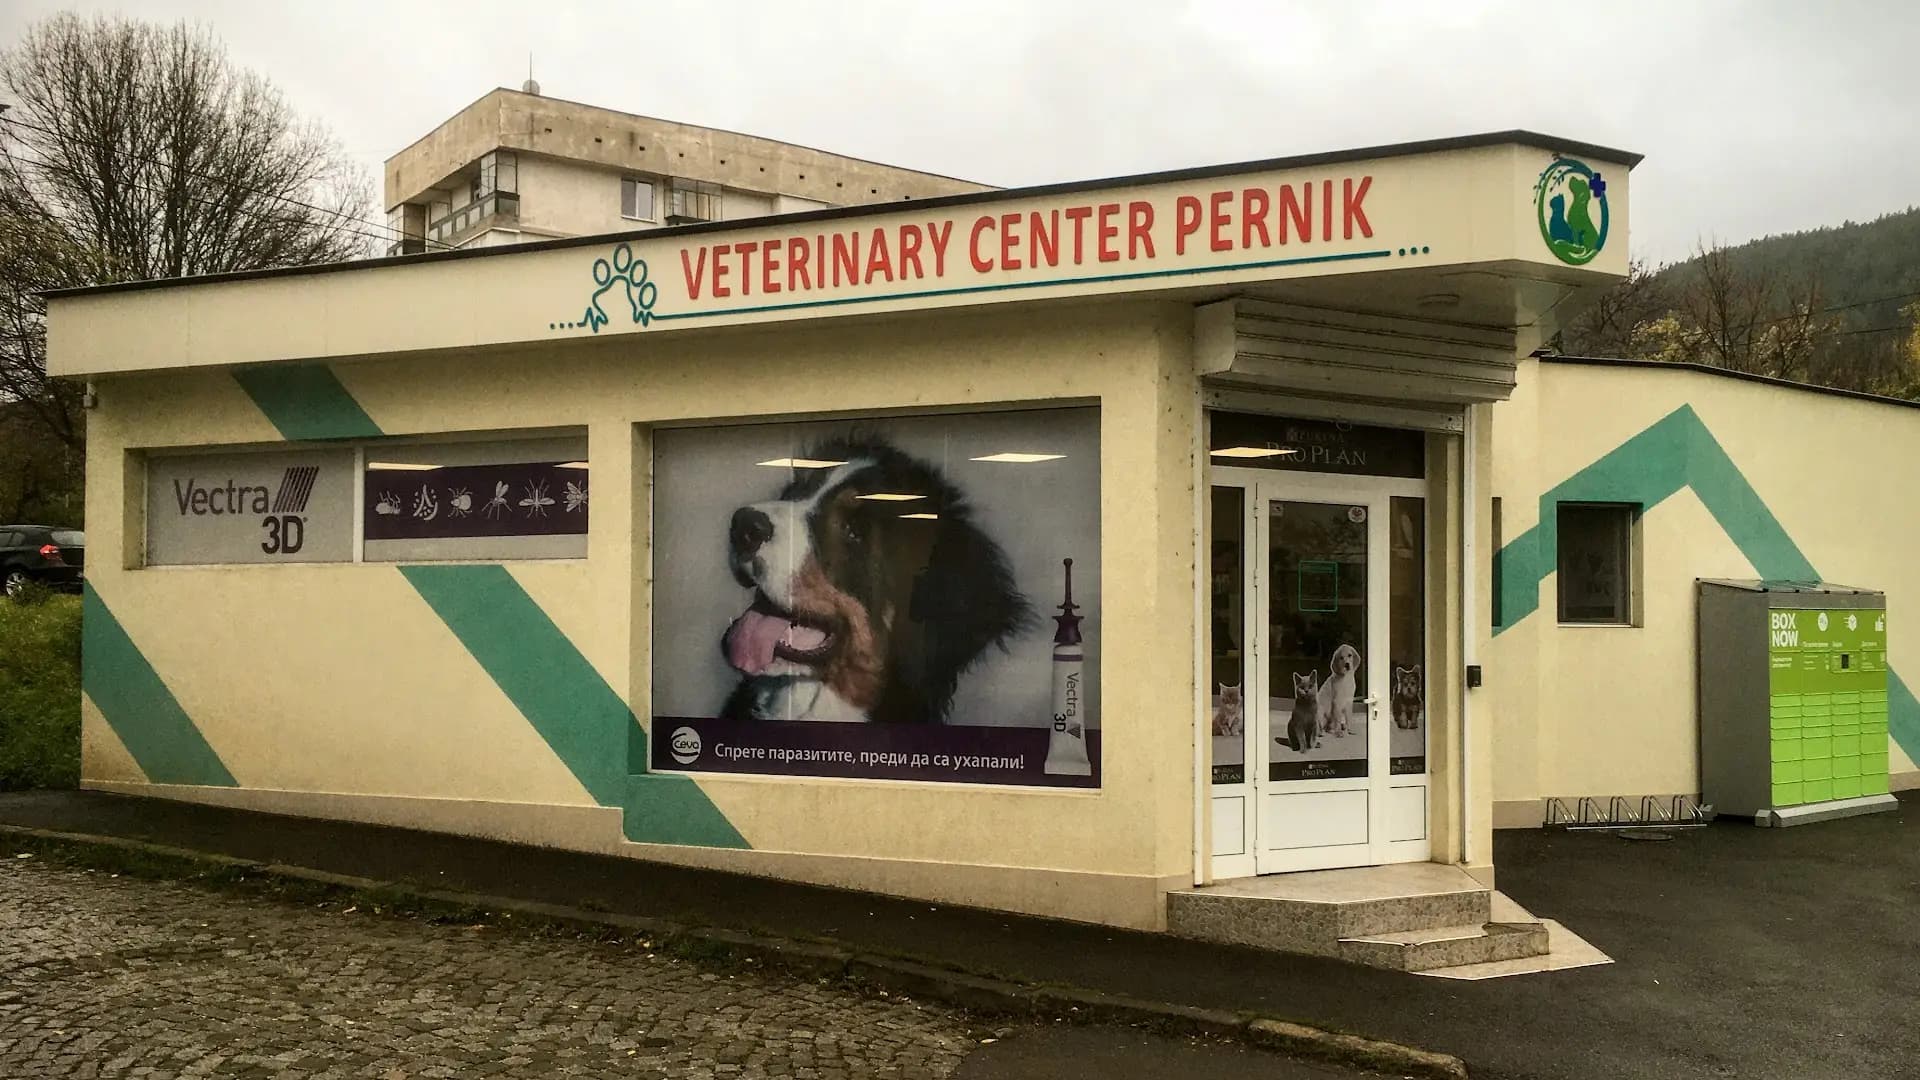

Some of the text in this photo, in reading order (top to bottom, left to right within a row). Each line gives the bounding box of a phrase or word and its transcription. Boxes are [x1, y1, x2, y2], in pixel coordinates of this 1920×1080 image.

[681, 176, 1373, 300] VETERINARY CENTER PERNIK
[172, 477, 269, 516] Vectra
[1771, 612, 1797, 630] BOX
[1771, 630, 1799, 648] NOW
[1065, 672, 1079, 717] Vectra
[1054, 713, 1066, 732] 3D
[714, 743, 1025, 772] Спрете паразитите, преди да са ухапали!
